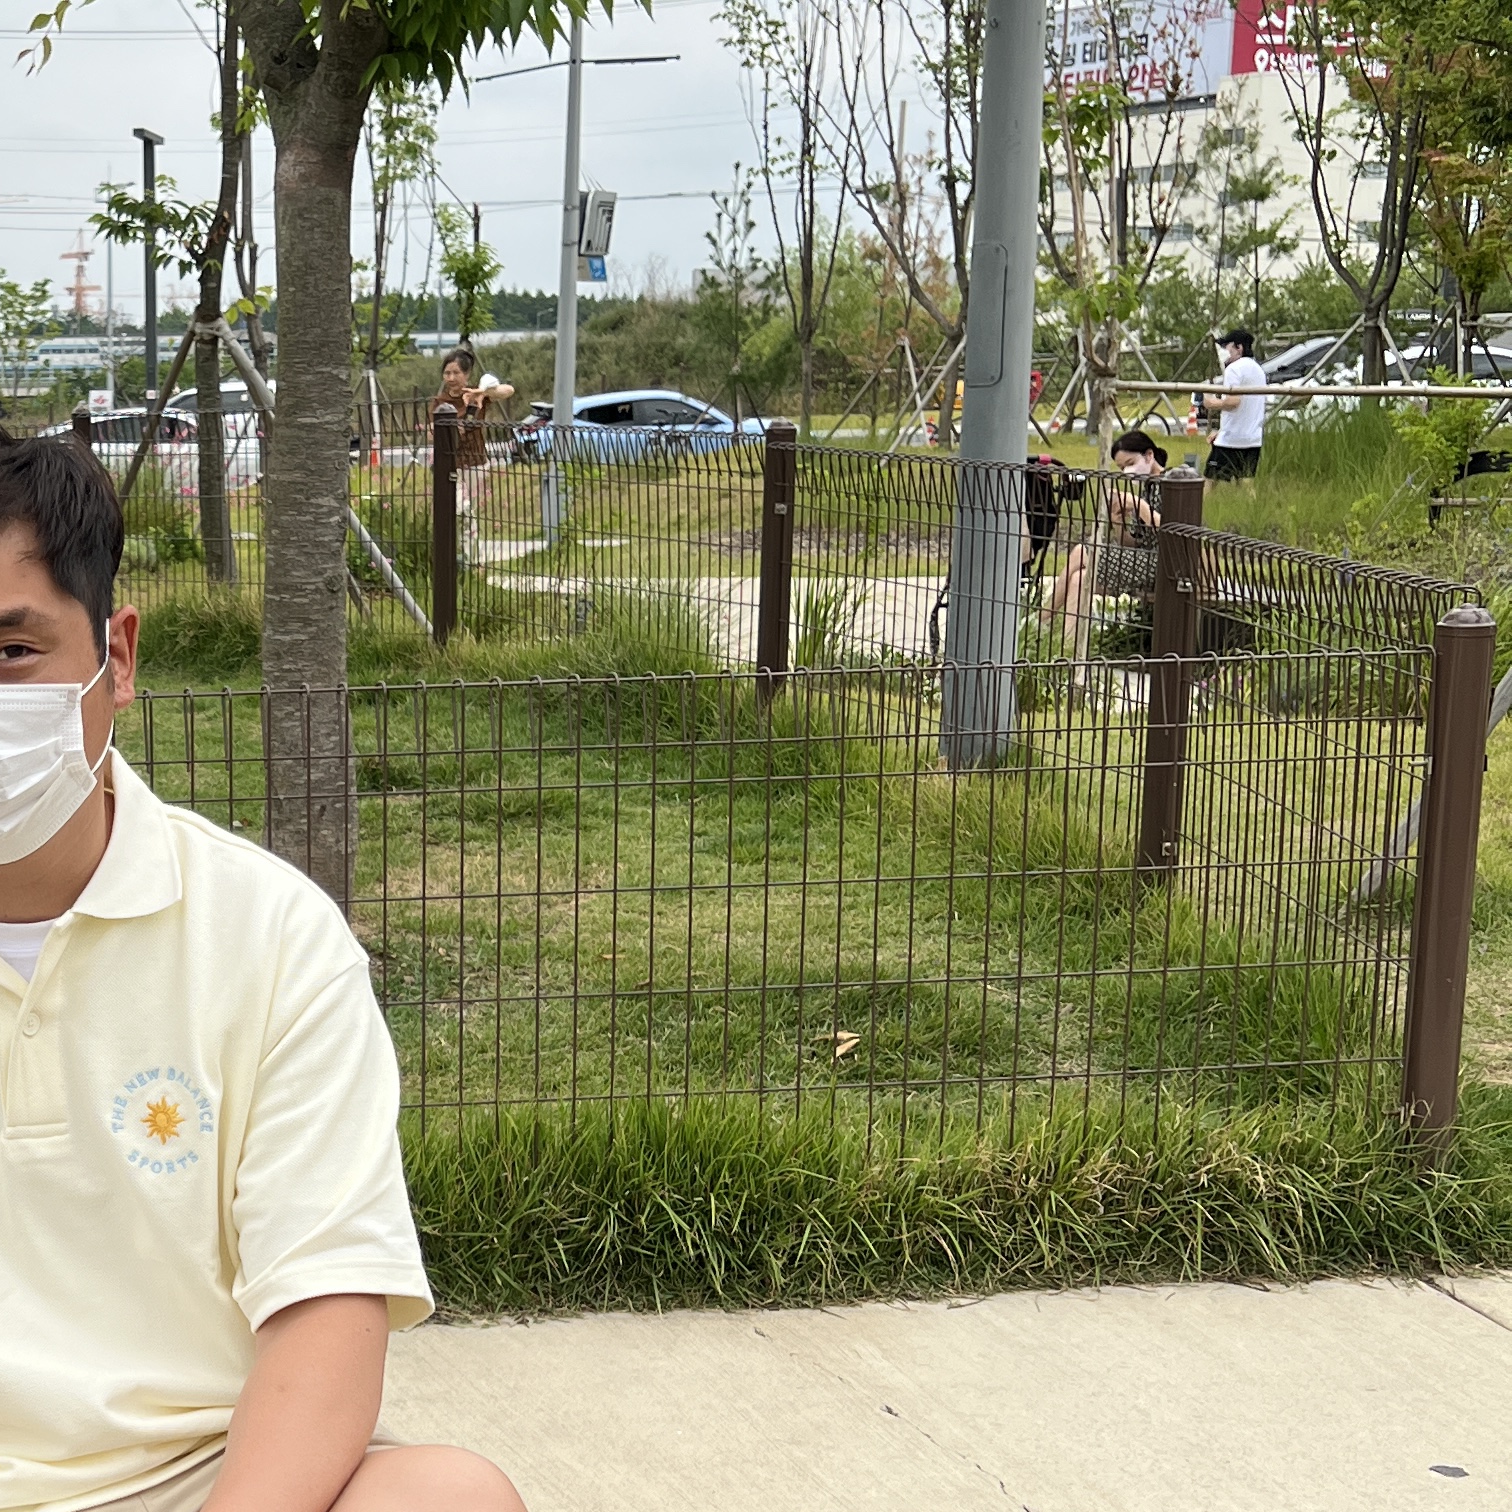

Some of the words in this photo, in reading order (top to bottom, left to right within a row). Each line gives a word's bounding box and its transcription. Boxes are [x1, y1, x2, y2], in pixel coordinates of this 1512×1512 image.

[111, 1095, 128, 1133] THE
[123, 1066, 160, 1094] NEW
[166, 1066, 214, 1132] BALANCE
[127, 1148, 199, 1174] SPORTS
